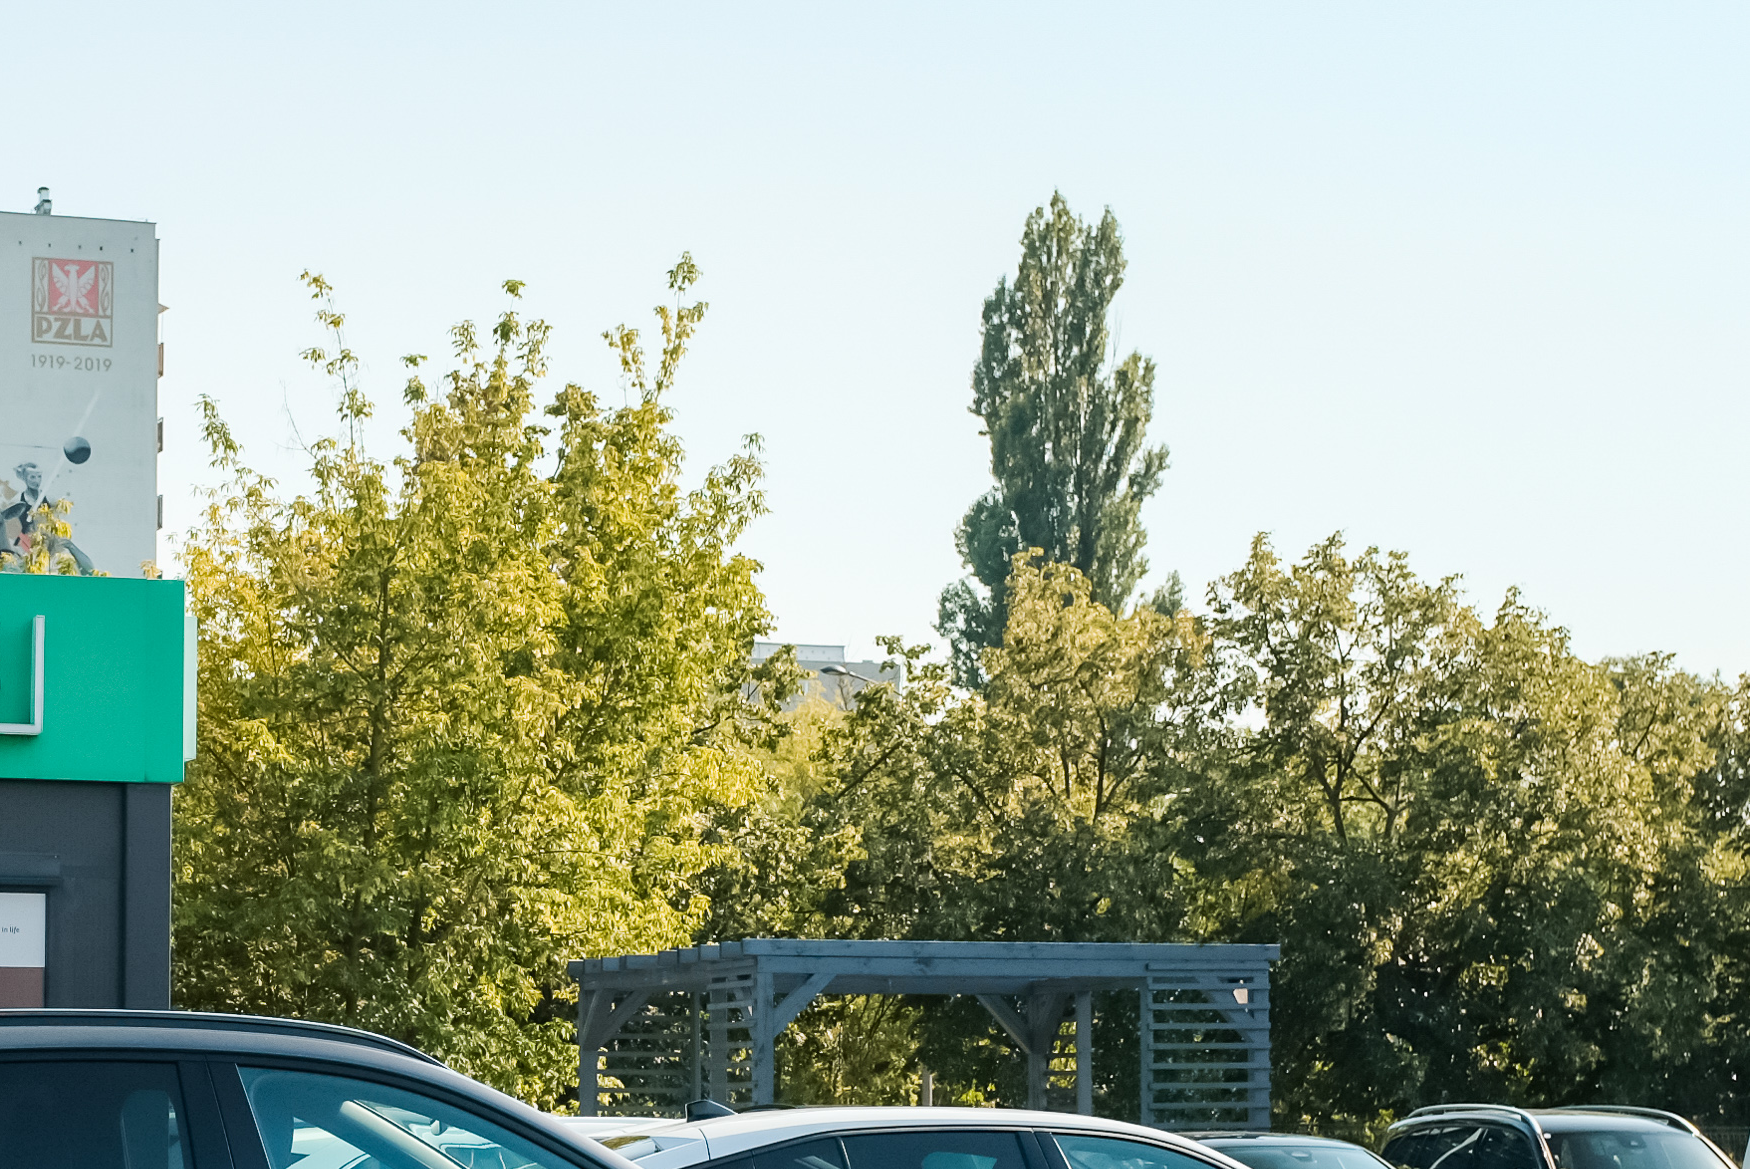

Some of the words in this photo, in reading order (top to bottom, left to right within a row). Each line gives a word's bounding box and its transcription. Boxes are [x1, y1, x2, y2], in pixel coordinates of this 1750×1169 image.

[36, 316, 108, 343] PZLA
[31, 353, 112, 372] 1919-2019
[1, 925, 8, 933] in
[9, 925, 20, 934] life
